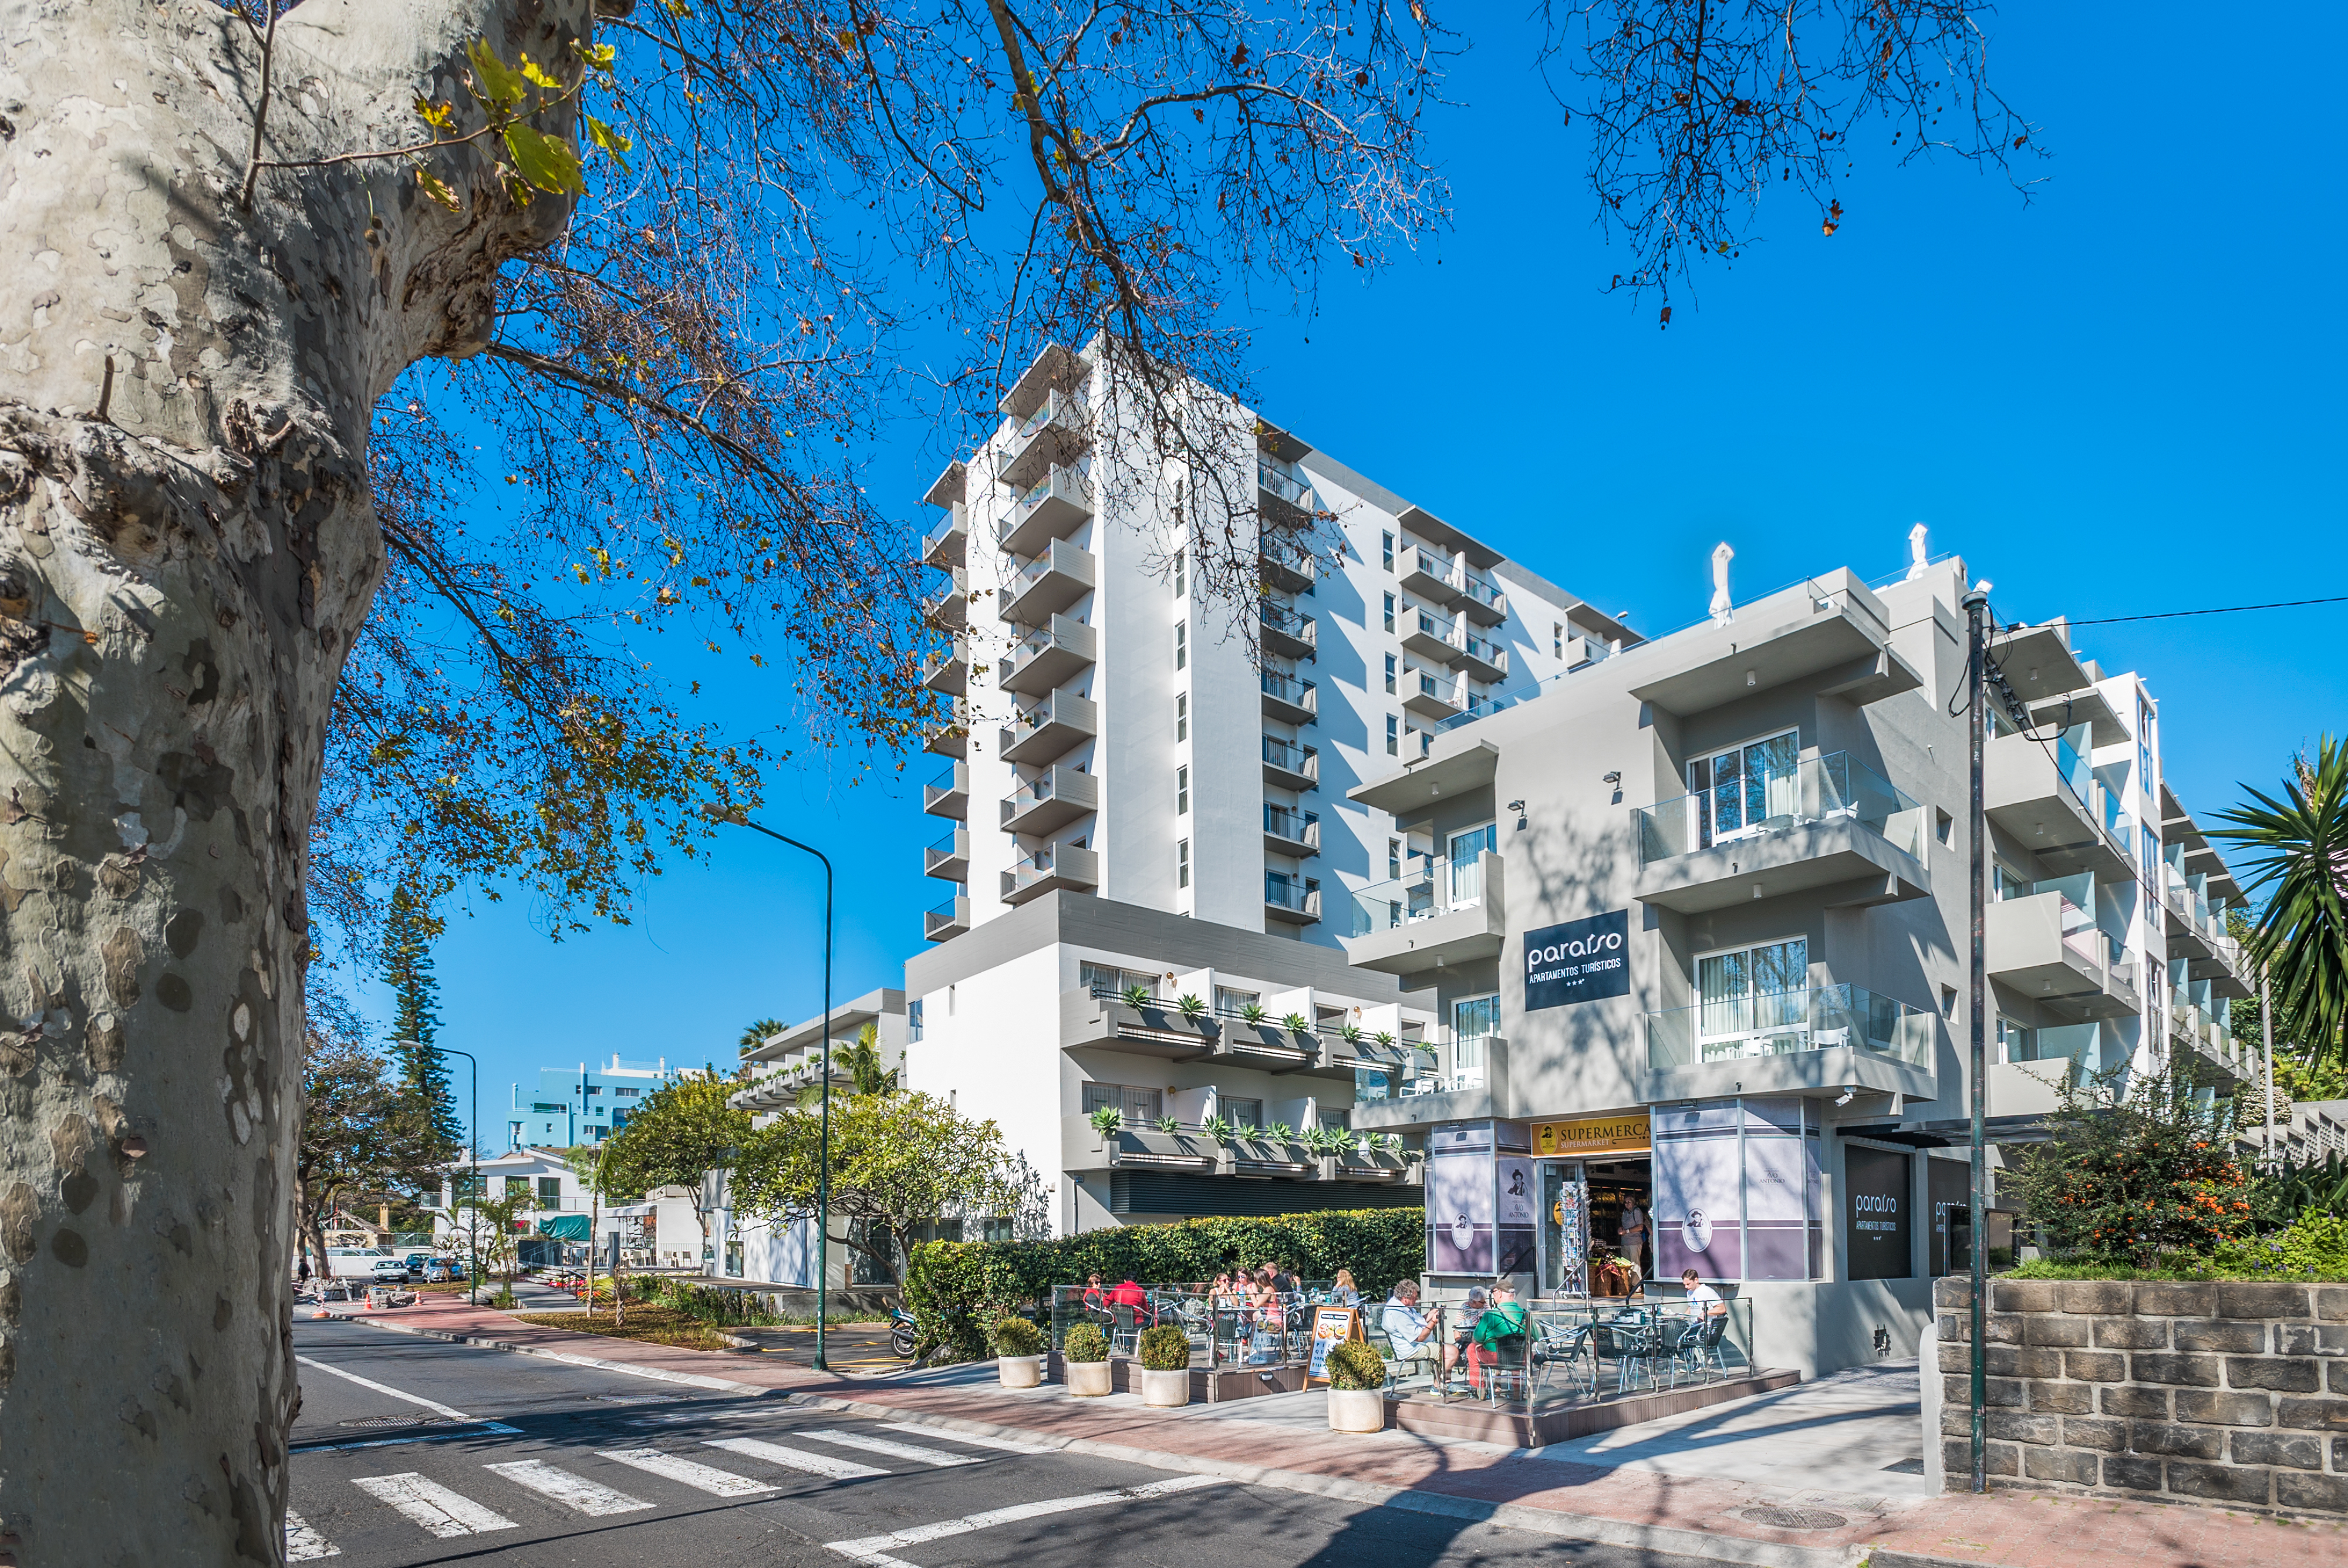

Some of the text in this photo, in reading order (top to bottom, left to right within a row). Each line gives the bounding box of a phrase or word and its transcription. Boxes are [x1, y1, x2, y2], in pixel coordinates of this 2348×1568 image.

[1529, 957, 1621, 984] APARTAMENTOS TURÍSTICOS
[1560, 1139, 1610, 1149] SUPERMARKET
[1856, 1220, 1879, 1230] APARTAMENTOS
